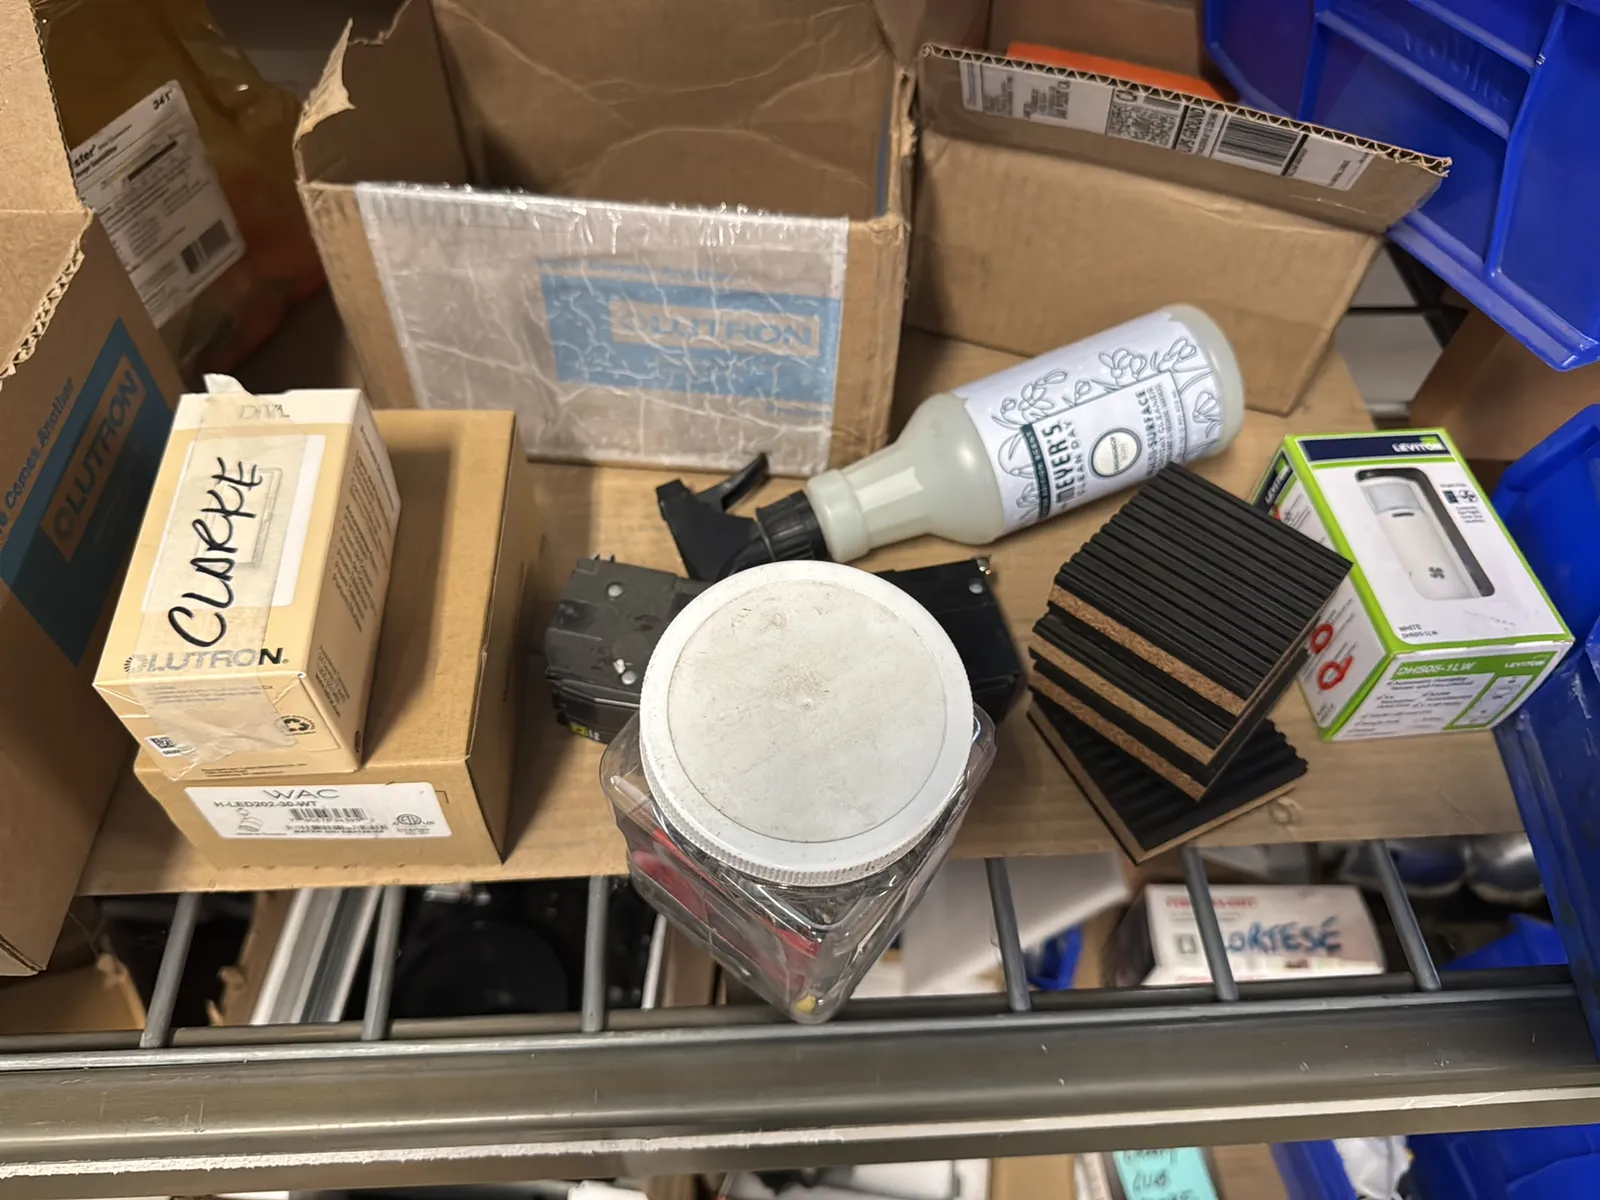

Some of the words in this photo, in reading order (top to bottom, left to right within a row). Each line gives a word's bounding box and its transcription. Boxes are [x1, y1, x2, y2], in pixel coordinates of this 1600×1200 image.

[1182, 107, 1206, 140] GROUND
[167, 456, 263, 648] CLARKE
[146, 647, 284, 672] LUTRON
[263, 788, 340, 800] WAC
